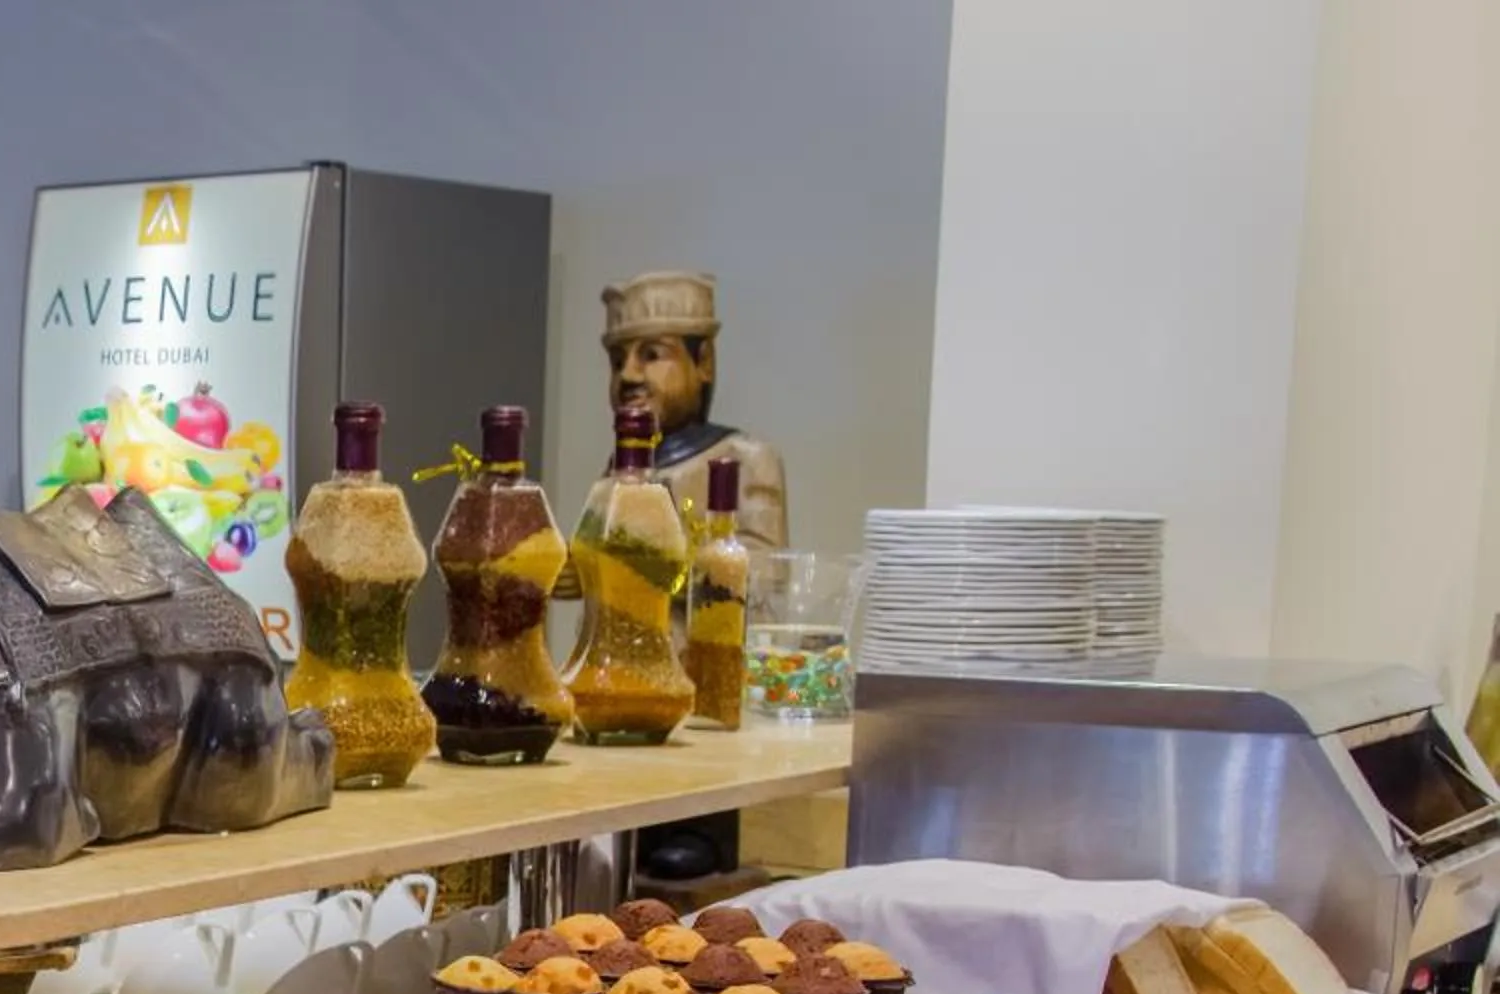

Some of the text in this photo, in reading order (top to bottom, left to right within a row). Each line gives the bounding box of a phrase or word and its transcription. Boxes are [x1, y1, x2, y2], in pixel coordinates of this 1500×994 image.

[42, 271, 277, 329] AVENUE
[100, 347, 210, 366] HOTEL DUBAI
